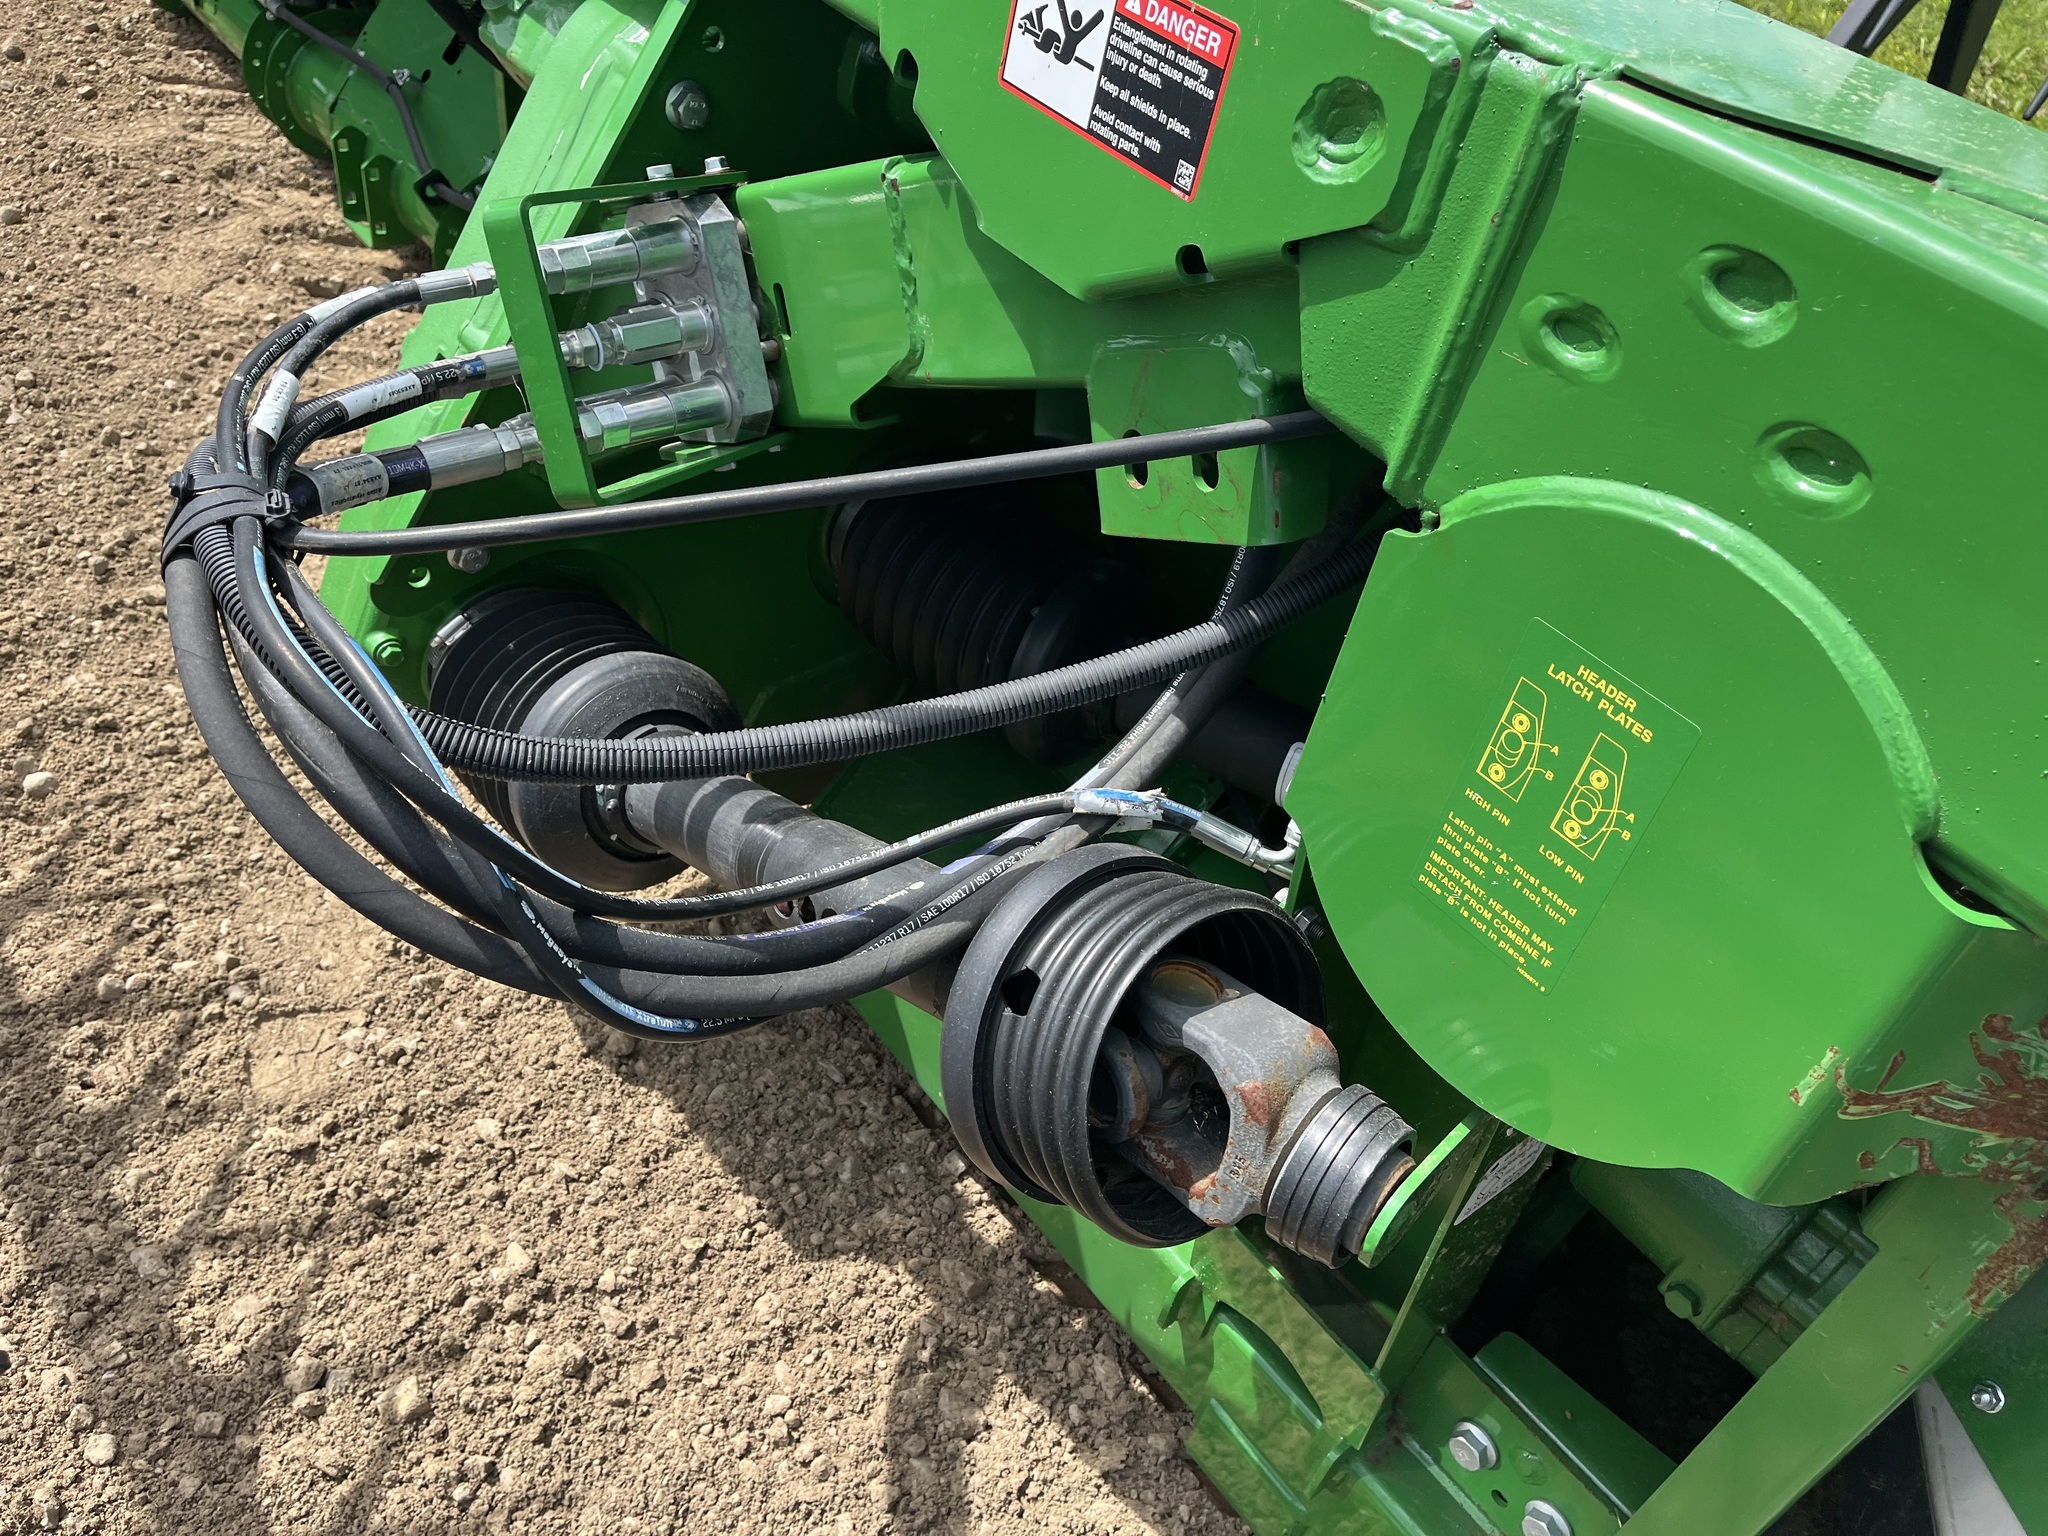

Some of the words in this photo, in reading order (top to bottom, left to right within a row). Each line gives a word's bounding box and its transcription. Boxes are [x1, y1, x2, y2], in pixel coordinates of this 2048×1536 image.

[1112, 16, 1167, 56] Entanglement
[1166, 45, 1175, 61] in
[1175, 53, 1209, 82] rotating
[1144, 0, 1221, 58] DANGER
[1105, 46, 1129, 71] injury
[1129, 62, 1139, 75] or
[1139, 65, 1162, 89] death.
[1109, 33, 1143, 59] driveline
[1142, 52, 1158, 69] can
[1158, 61, 1183, 82] cause
[1183, 75, 1215, 101] serious
[1099, 75, 1119, 98] Keep
[1119, 88, 1131, 102] all
[1129, 94, 1158, 120] shields
[1158, 109, 1167, 125] in
[1167, 118, 1191, 139] place.
[1089, 120, 1119, 146] rotating
[1118, 137, 1140, 158] parts.
[1092, 104, 1115, 126] Avoid
[1115, 119, 1144, 143] contact
[1143, 135, 1161, 154] with
[1225, 578, 1236, 594] ISO
[1148, 686, 1176, 720] Resistant
[1547, 663, 1594, 702] LATCH
[1597, 698, 1653, 743] PLATES
[1577, 665, 1637, 713] HEADER
[1128, 719, 1150, 742] MSHA
[1550, 746, 1559, 756] A
[1545, 770, 1554, 781] B
[920, 822, 950, 840] Flame
[951, 807, 997, 827] Resistant
[997, 799, 1026, 813] MSHA
[1465, 787, 1491, 812] HIGH
[1491, 808, 1511, 827] PIN
[1626, 813, 1635, 824] A
[1436, 836, 1461, 858] plate
[1462, 857, 1486, 878] over.
[1621, 830, 1631, 841] B
[819, 864, 836, 874] ISO
[837, 852, 869, 872] 18752
[869, 845, 892, 859] Type
[1443, 823, 1463, 843] thru
[1463, 841, 1489, 864] plate
[1512, 878, 1522, 889] If
[1522, 887, 1542, 908] not,
[1544, 904, 1567, 926] turn
[1448, 811, 1475, 836] Latch
[1476, 835, 1494, 851] pin
[1513, 864, 1540, 888] must
[1541, 886, 1578, 916] extend
[1539, 844, 1565, 867] LOW
[1564, 865, 1585, 884] PIN
[868, 932, 898, 955] 11237
[897, 920, 916, 938] R17
[920, 906, 940, 923] SAE
[940, 885, 971, 912] 100R17
[974, 872, 991, 887] ISO
[990, 855, 1017, 878] 18752
[1418, 874, 1442, 895] plate
[1460, 906, 1469, 918] is
[1470, 916, 1487, 932] not
[1487, 929, 1498, 942] in
[1498, 940, 1527, 967] place.
[1424, 861, 1462, 896] DETACH
[1462, 893, 1493, 921] FROM
[1493, 918, 1541, 960] COMBINE
[1540, 957, 1553, 968] IF
[1429, 850, 1487, 901] IMPORTANT:
[1488, 898, 1531, 936] HEADER
[1531, 932, 1554, 954] MAY
